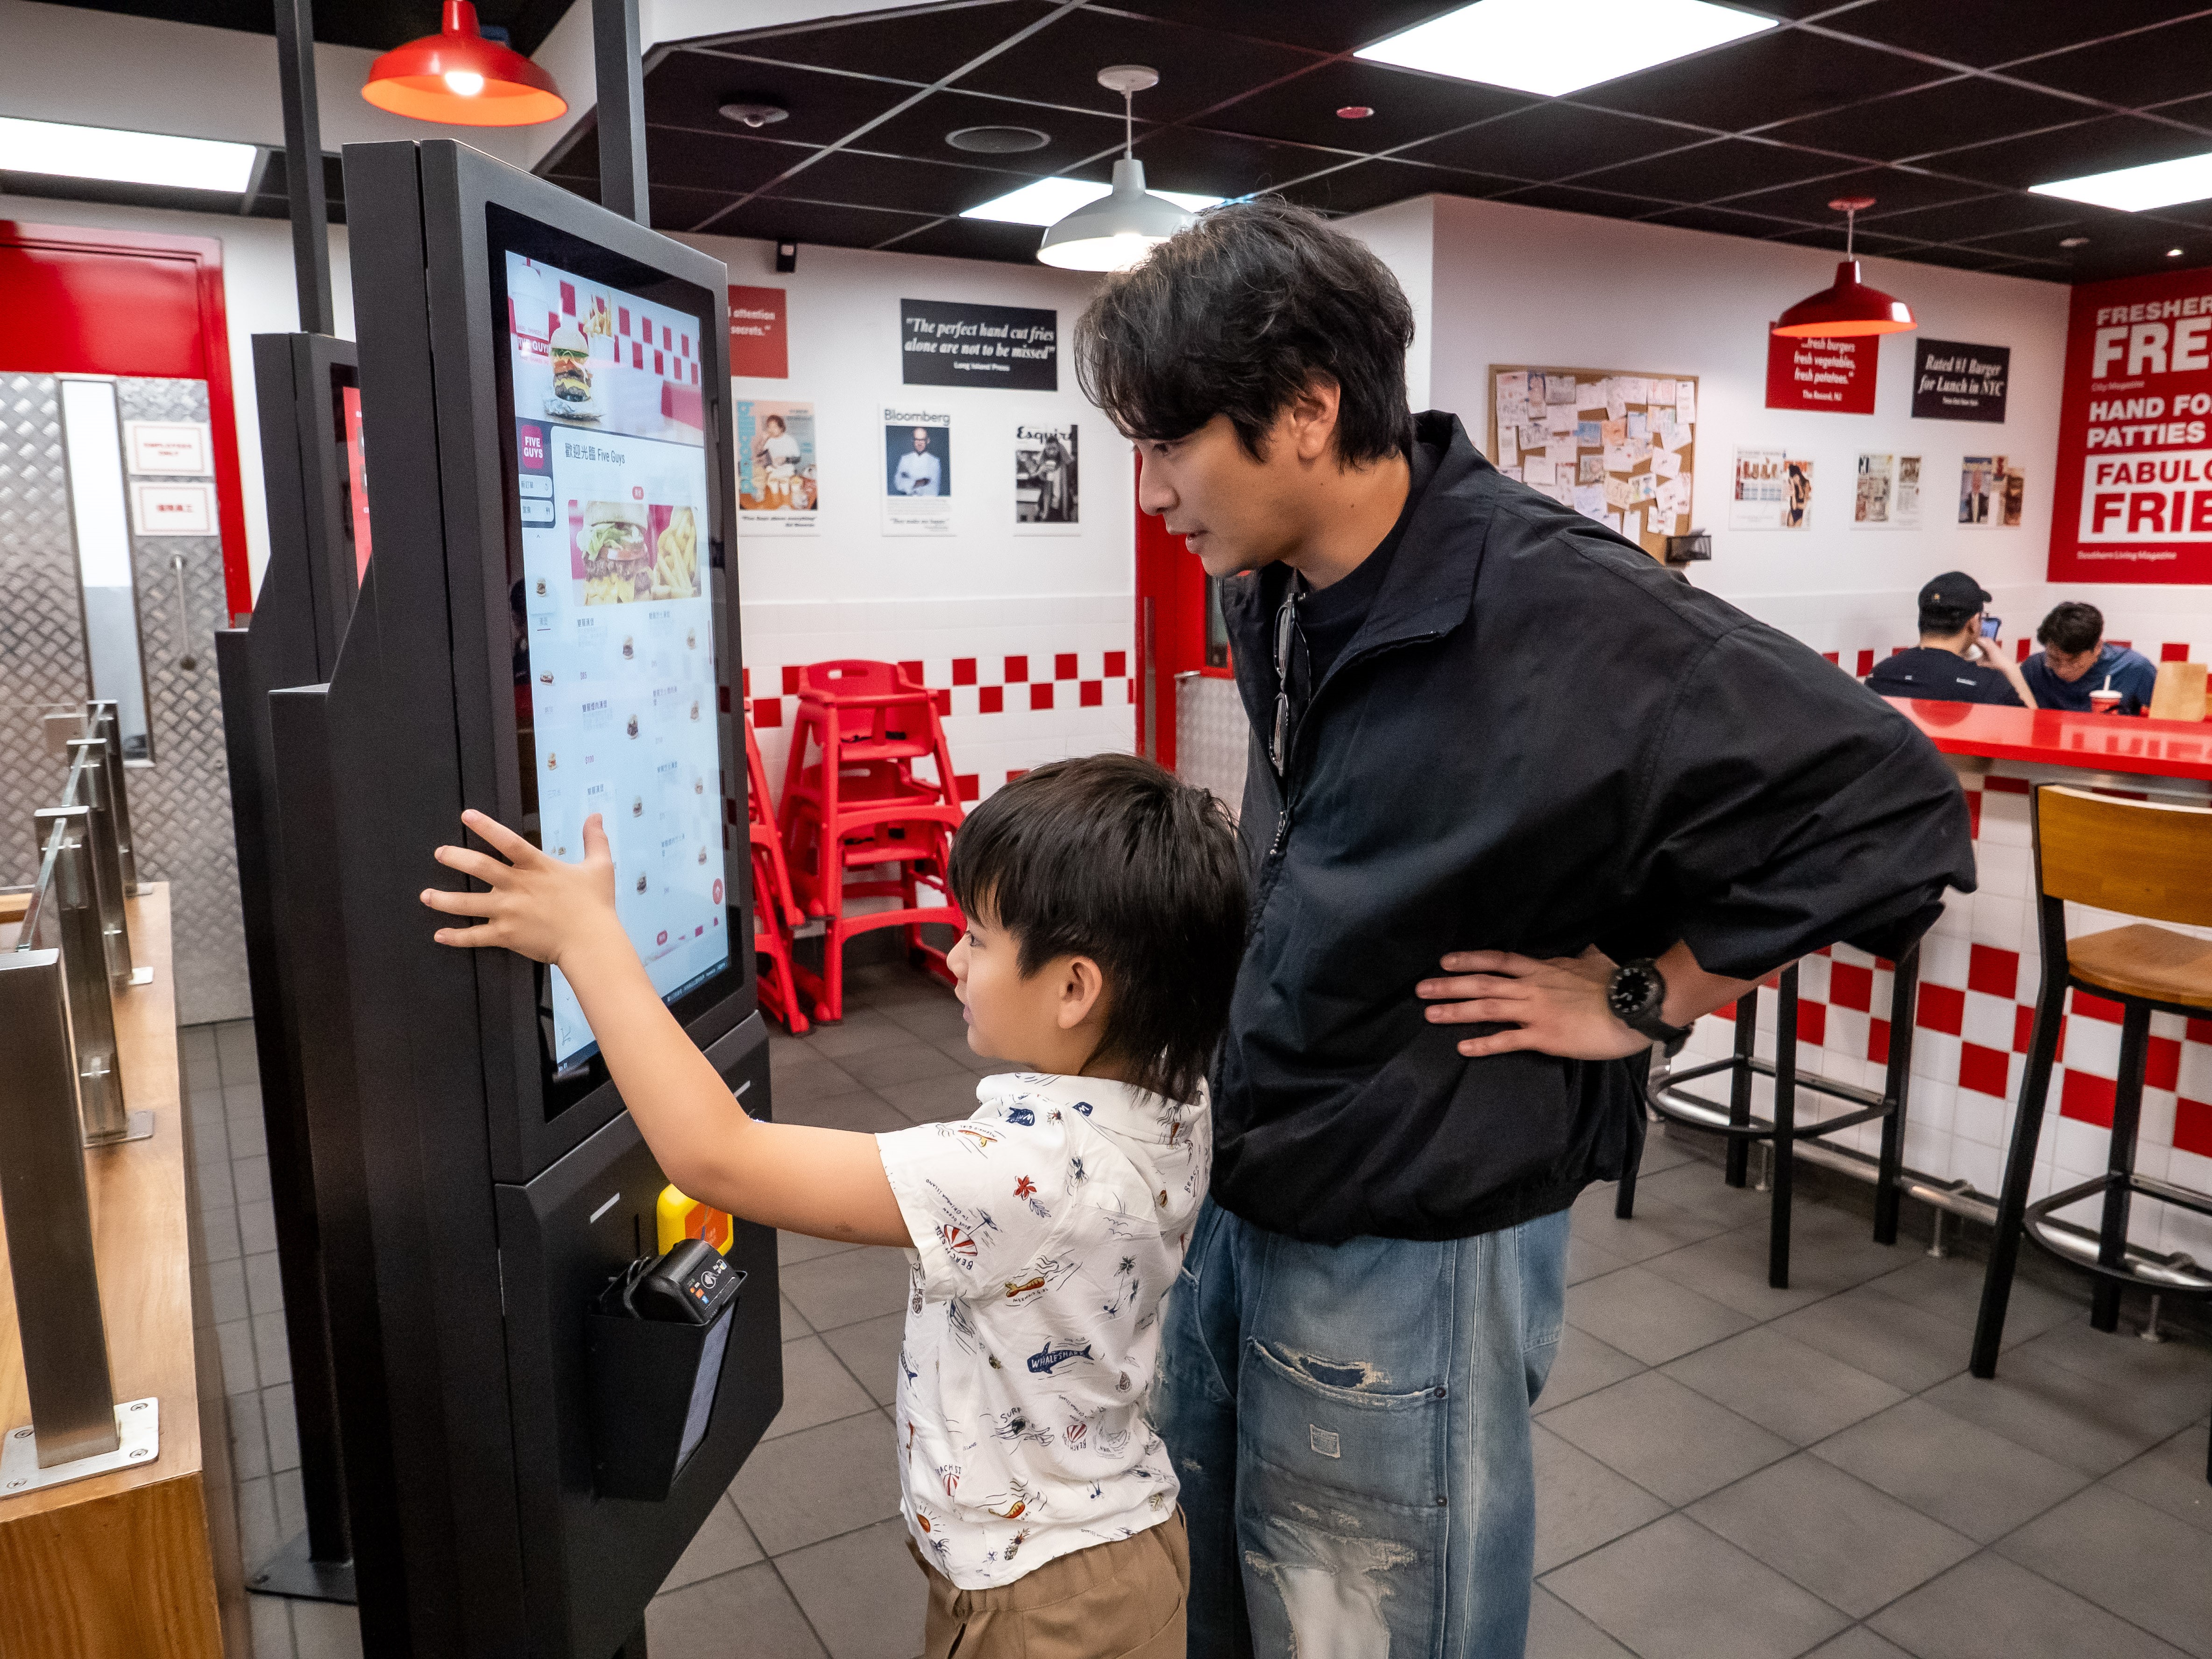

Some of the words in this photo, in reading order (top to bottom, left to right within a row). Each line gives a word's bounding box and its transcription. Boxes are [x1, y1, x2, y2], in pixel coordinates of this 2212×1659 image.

[936, 321, 977, 338] perfect
[979, 323, 1008, 338] hand
[1010, 328, 1028, 339] cut
[1028, 326, 1054, 343] fries
[904, 338, 938, 353] alone
[939, 343, 959, 354] are
[961, 343, 980, 355] not
[982, 344, 993, 356] to
[995, 342, 1010, 357] be
[1827, 338, 1856, 354] burgers
[2091, 316, 2212, 379] FRE
[1794, 350, 1813, 365] fresh
[1794, 367, 1814, 382] fresh
[1925, 354, 1955, 372] Rated
[1968, 358, 2002, 380] Burger
[1918, 374, 1936, 394] for
[1937, 375, 1967, 393] Lunch
[1968, 378, 1979, 395] in
[1980, 380, 2005, 397] NYC
[2089, 397, 2165, 423] HAND
[2173, 392, 2212, 417] FO
[885, 409, 950, 426] Bloomberg
[525, 436, 541, 447] FIVE
[2086, 421, 2206, 449] PATTIES
[524, 447, 543, 459] GUYS
[598, 448, 610, 462] Five
[611, 450, 625, 466] Guys
[2092, 490, 2212, 534] FRIE
[1000, 1407, 1021, 1423] SURF
